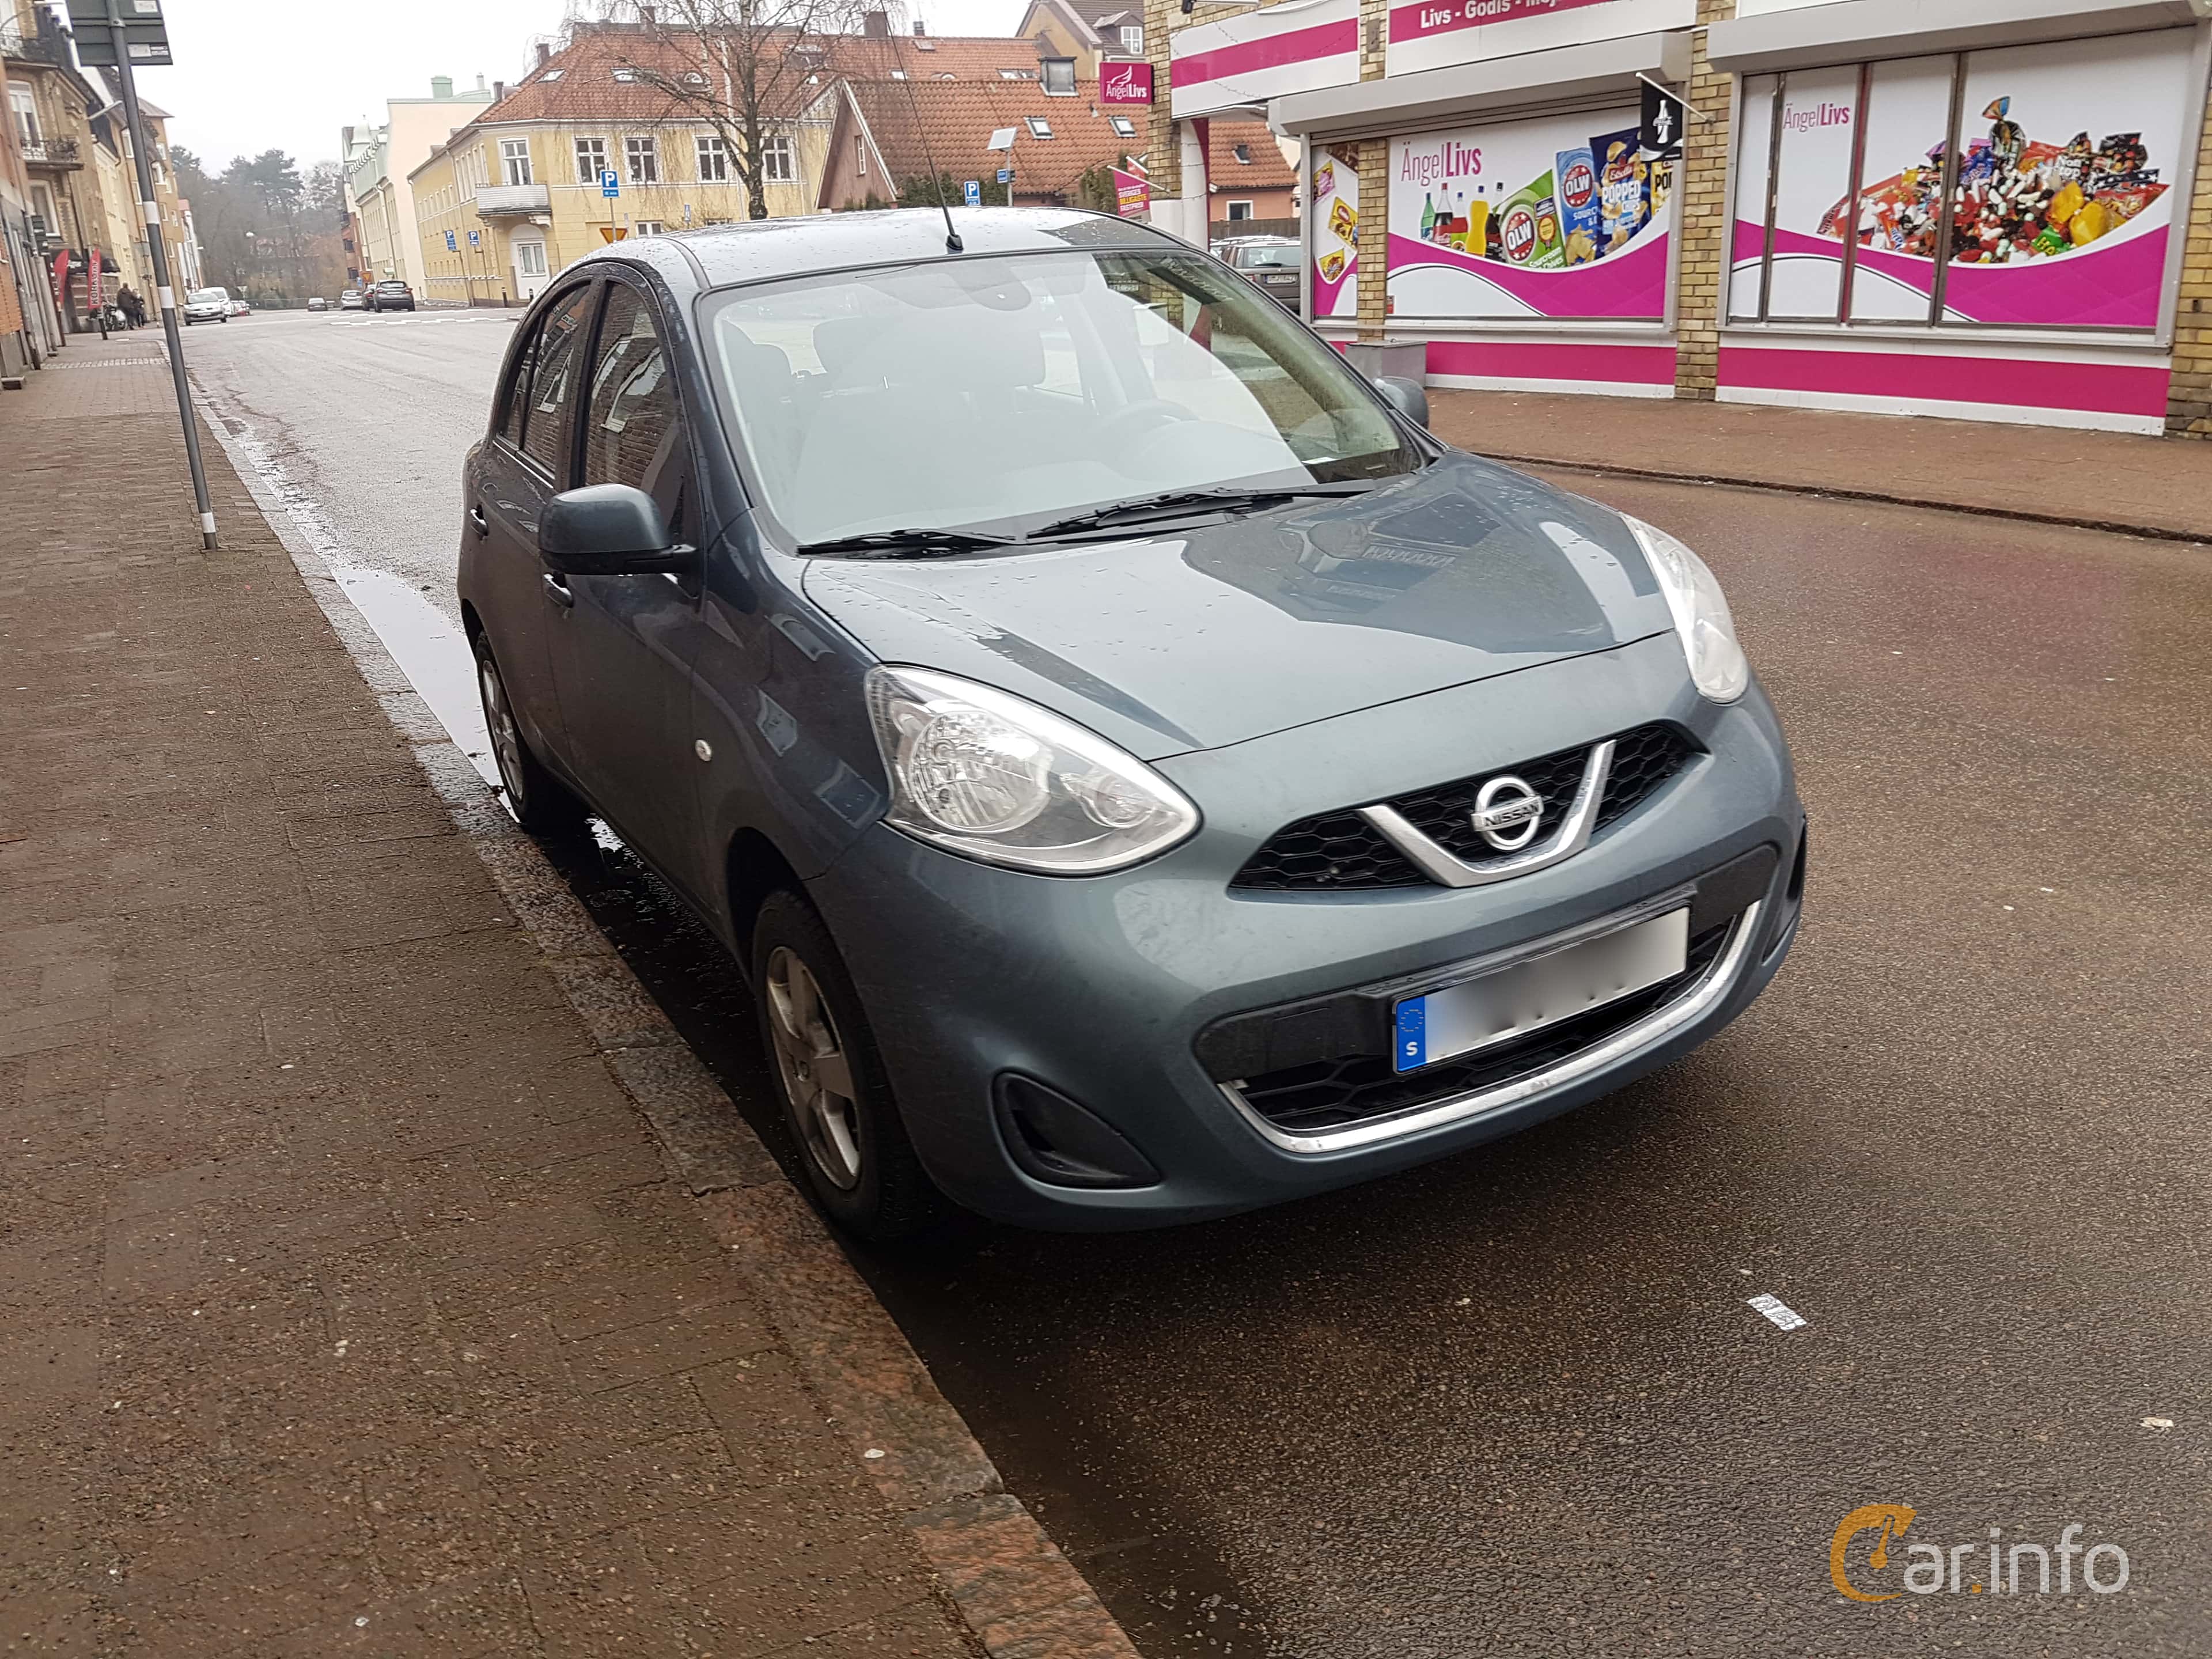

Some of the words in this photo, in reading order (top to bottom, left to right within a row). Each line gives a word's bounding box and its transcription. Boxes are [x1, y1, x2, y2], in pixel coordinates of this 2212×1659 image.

[1421, 9, 1452, 28] Livs
[1464, 0, 1511, 19] Godis
[1783, 103, 1850, 132] ÄngelLivs
[1401, 141, 1482, 187] ÄngelLivs
[605, 172, 615, 187] P
[968, 183, 976, 196] P
[1566, 173, 1590, 196] OLW
[469, 232, 476, 240] P
[1507, 220, 1532, 250] OLW
[1484, 804, 1539, 827] NISSAN
[1406, 1041, 1418, 1056] S
